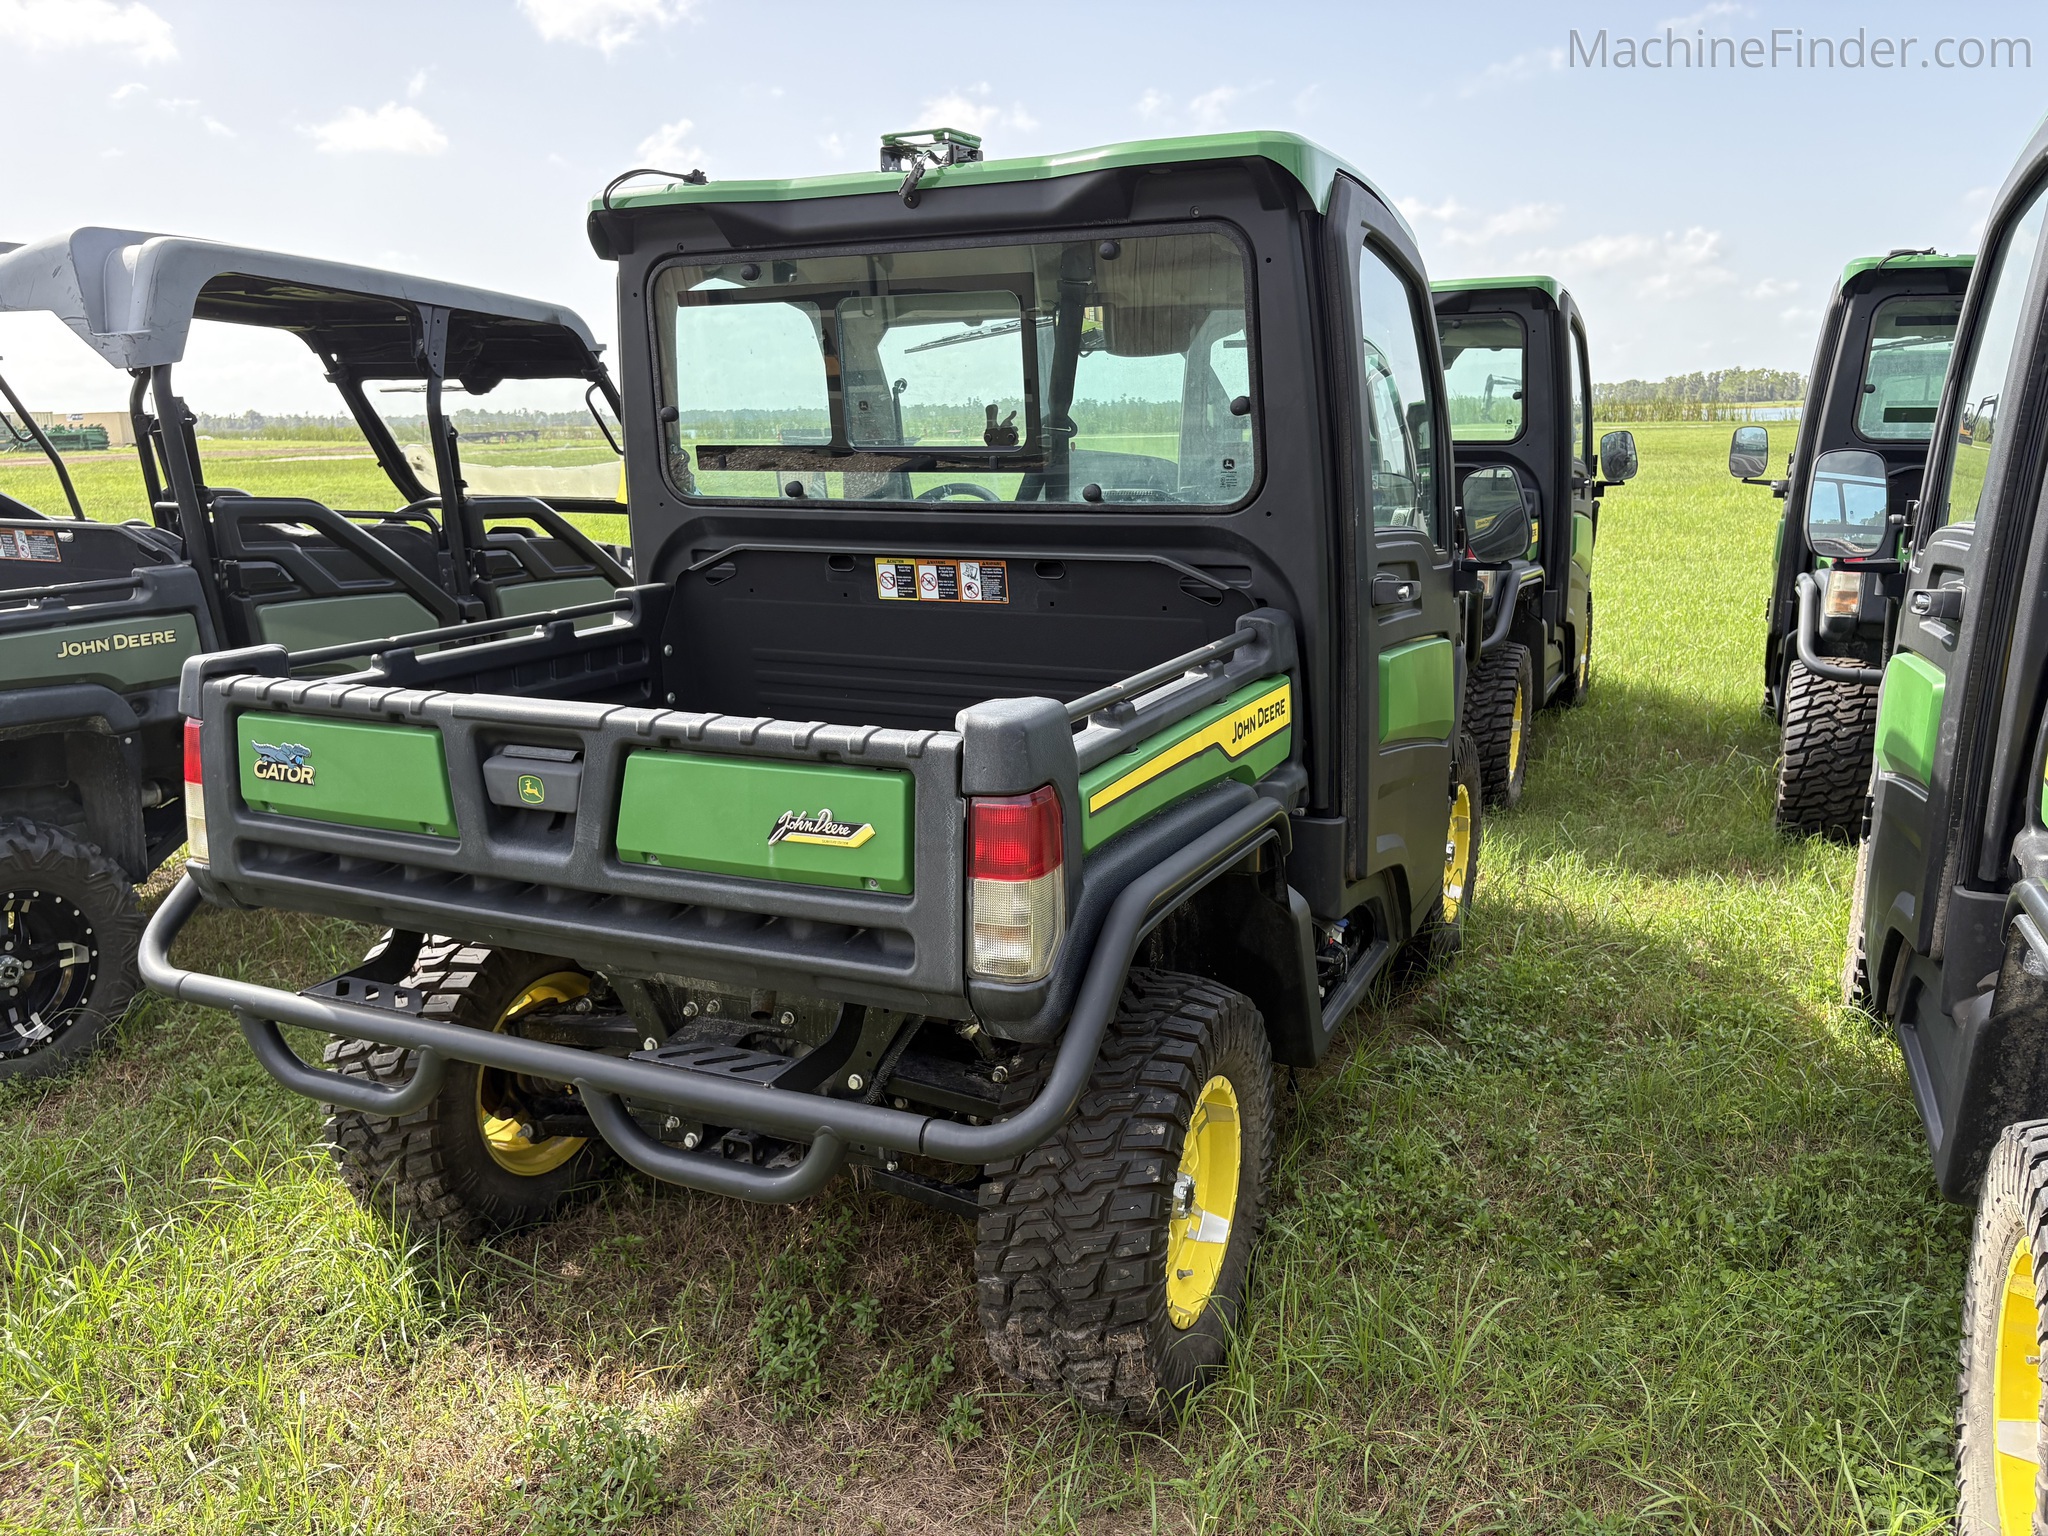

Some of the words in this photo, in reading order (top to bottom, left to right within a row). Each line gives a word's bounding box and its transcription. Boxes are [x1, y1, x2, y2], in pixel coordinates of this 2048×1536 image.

[57, 638, 110, 658] JOHN
[113, 630, 176, 650] DEERE
[1232, 714, 1256, 743] JOHN
[1257, 699, 1285, 728] DEERE
[253, 759, 314, 784] GATOR
